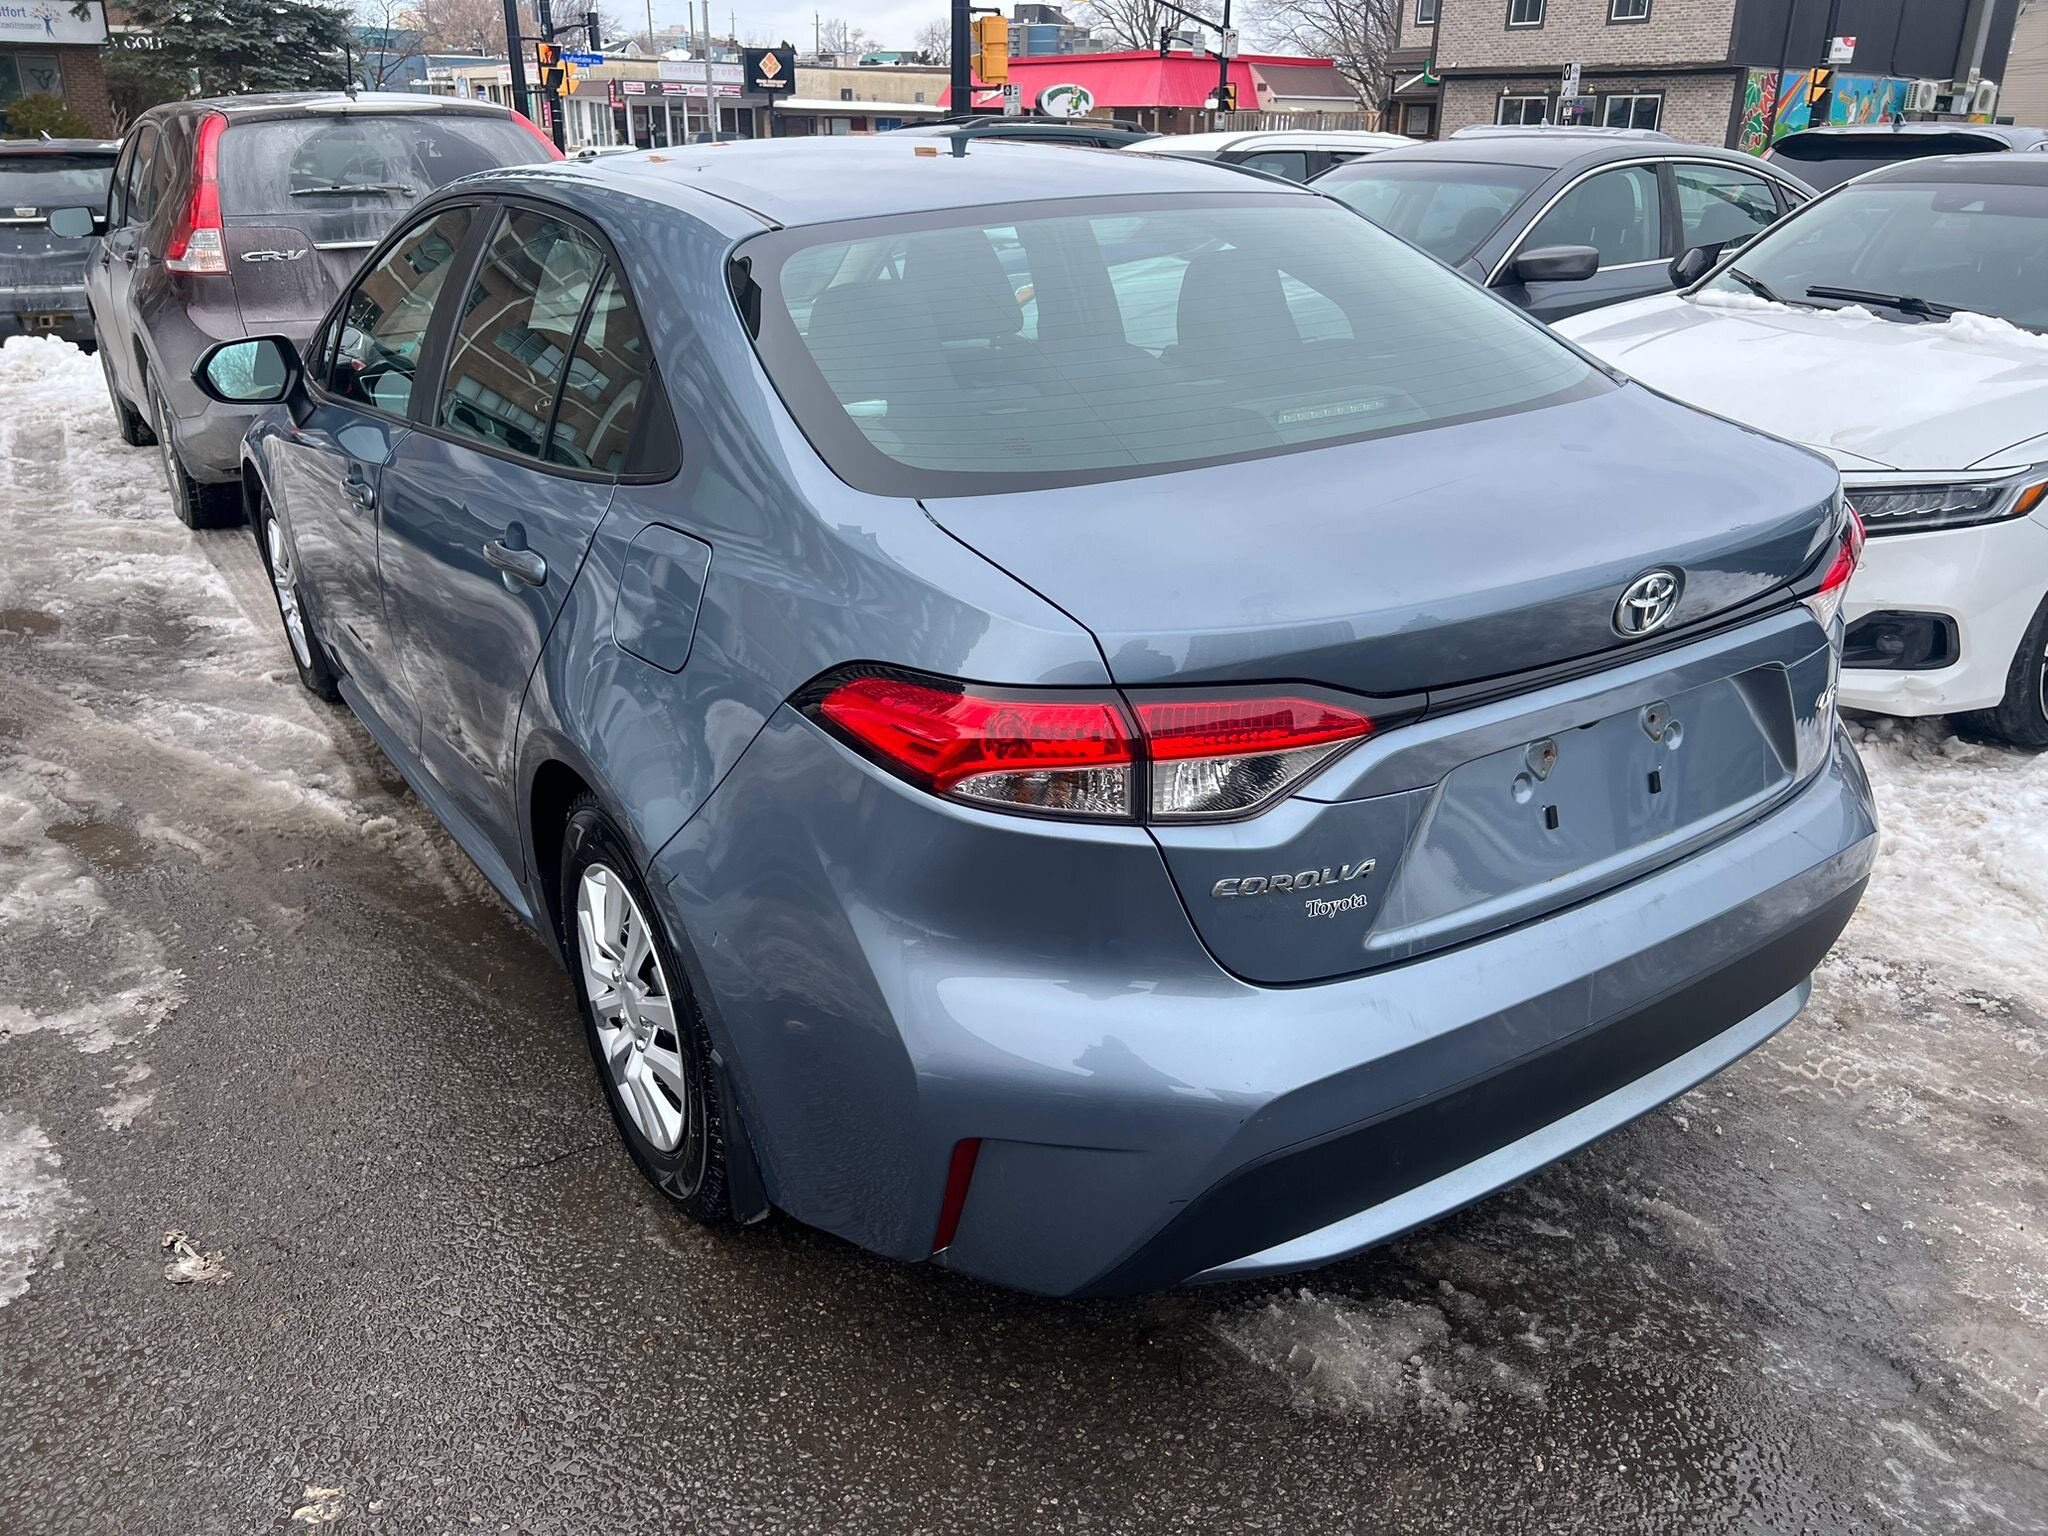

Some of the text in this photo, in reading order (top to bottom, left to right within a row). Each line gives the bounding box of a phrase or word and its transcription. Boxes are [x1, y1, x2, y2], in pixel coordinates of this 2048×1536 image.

[241, 249, 307, 262] CR-V
[1211, 857, 1376, 897] COROLLA
[1306, 894, 1367, 918] Toyota
